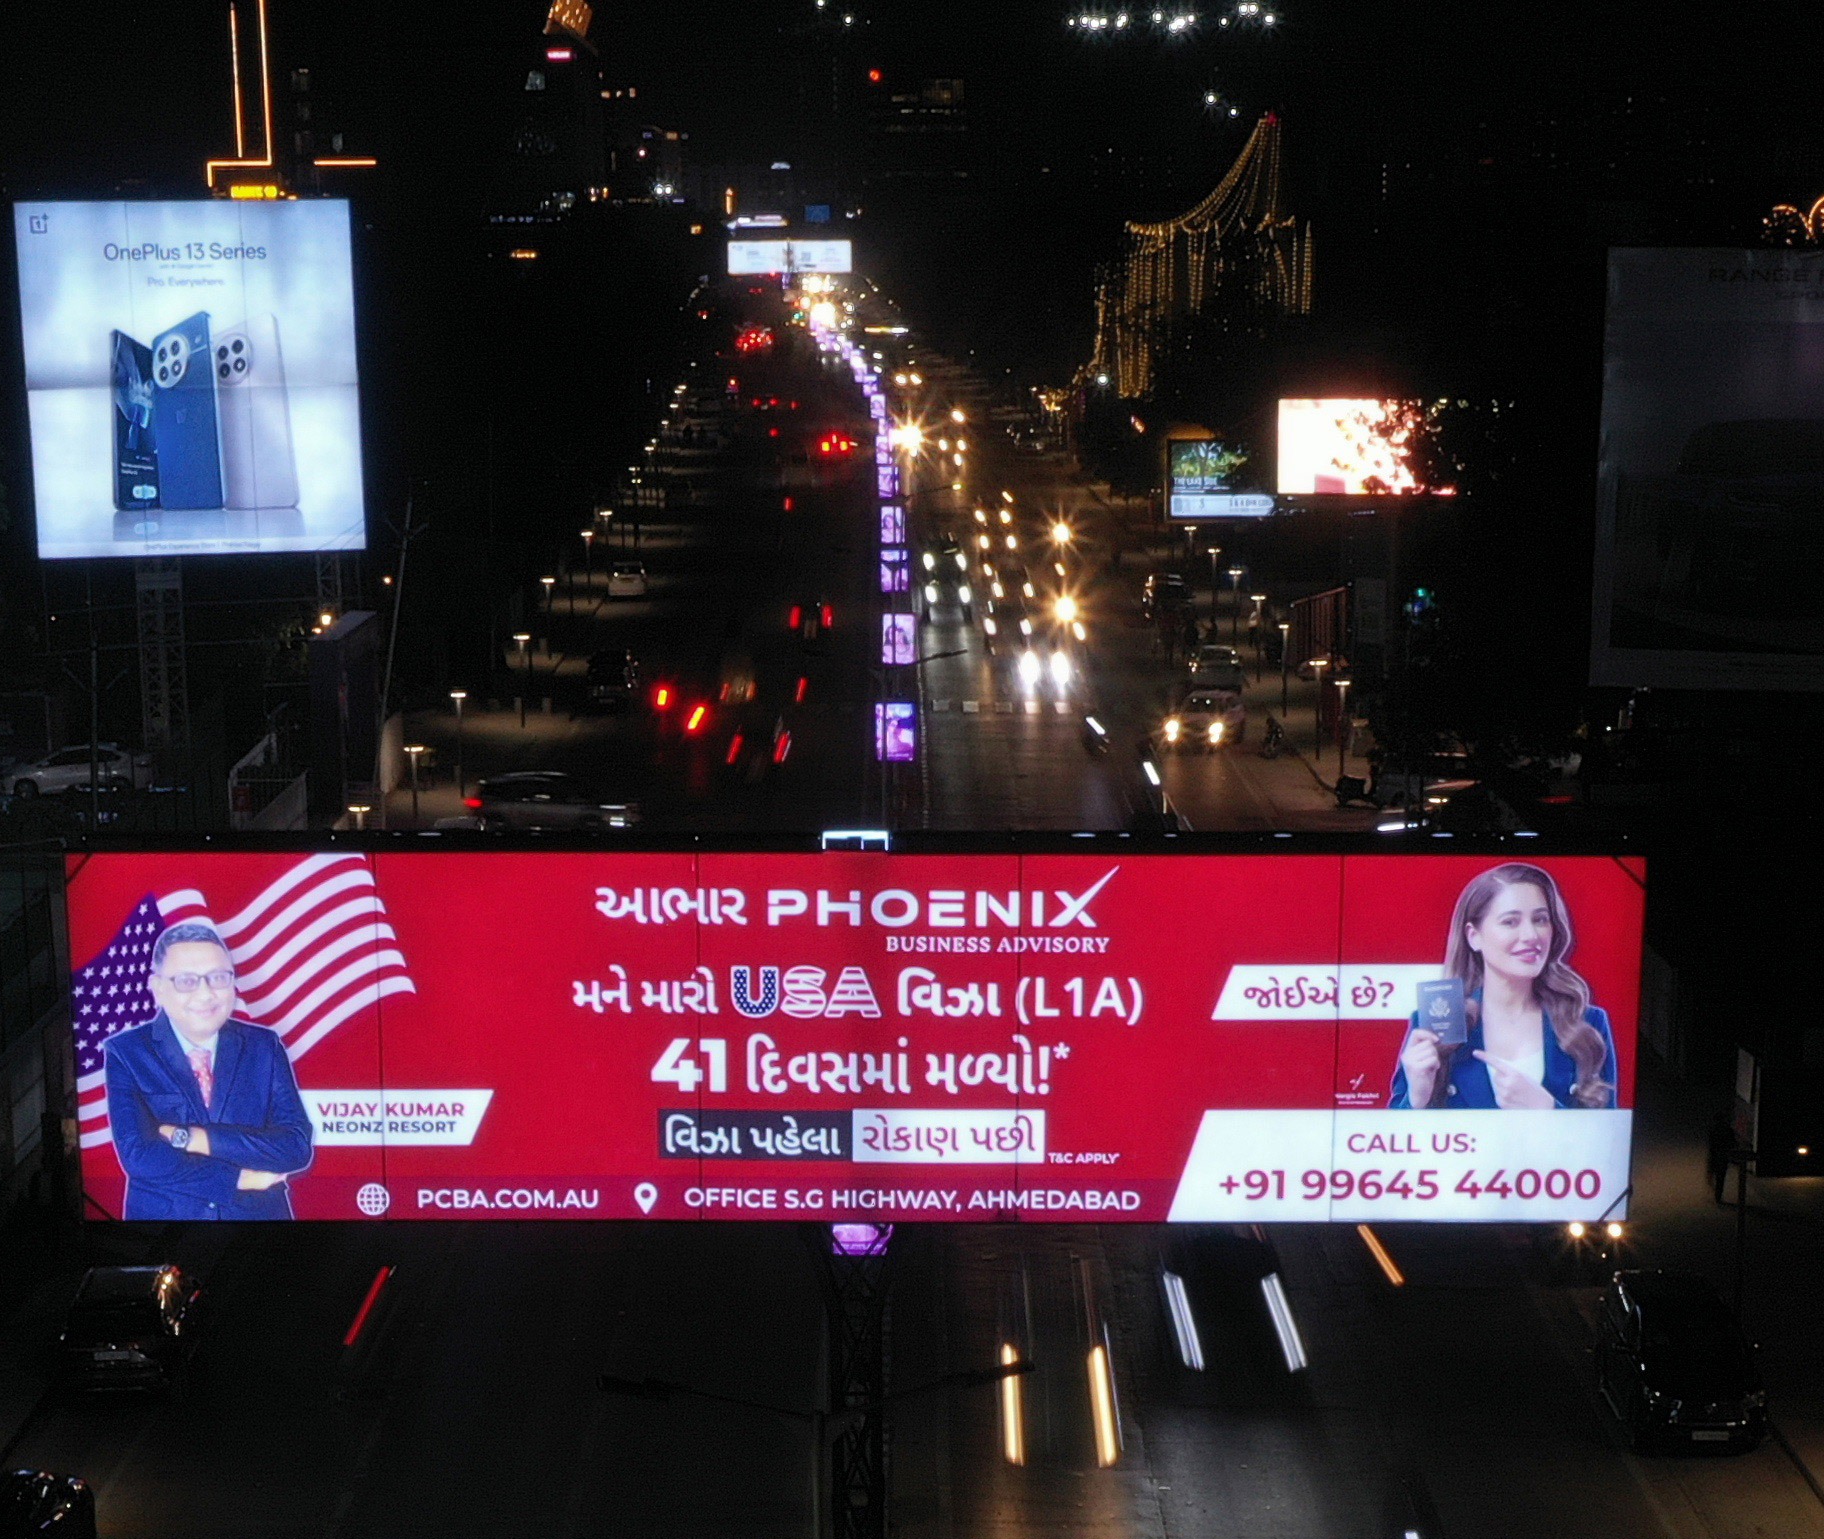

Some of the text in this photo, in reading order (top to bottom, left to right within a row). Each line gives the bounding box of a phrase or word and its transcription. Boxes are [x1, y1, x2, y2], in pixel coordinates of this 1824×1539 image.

[104, 242, 267, 261] OnePlus 13 Series
[1709, 268, 1809, 283] RANGE
[595, 865, 1120, 928] આભાર PHOENIX
[886, 936, 1110, 954] BUSINESS ADVISORY
[572, 964, 1144, 1026] મને મારો USA વિઝા (L1A)
[1244, 976, 1394, 1009] જોઈએ છે?
[650, 1036, 727, 1093] 41
[746, 1033, 909, 1094] દિવસમાં
[317, 1102, 465, 1118] VIJAY KUMAR
[322, 1121, 456, 1133] NEONZ RESORT
[665, 1113, 1037, 1156] વિઝા પહેલા રોકાણ પછી
[1347, 1133, 1477, 1153] CALL US:
[1048, 1152, 1073, 1164] T&C
[1219, 1168, 1602, 1200] +91 99645 44000
[417, 1189, 599, 1209] PCBA.COM.AU
[684, 1188, 1140, 1213] OFFICE S.G HIGHWAY, AHMEDABAD
